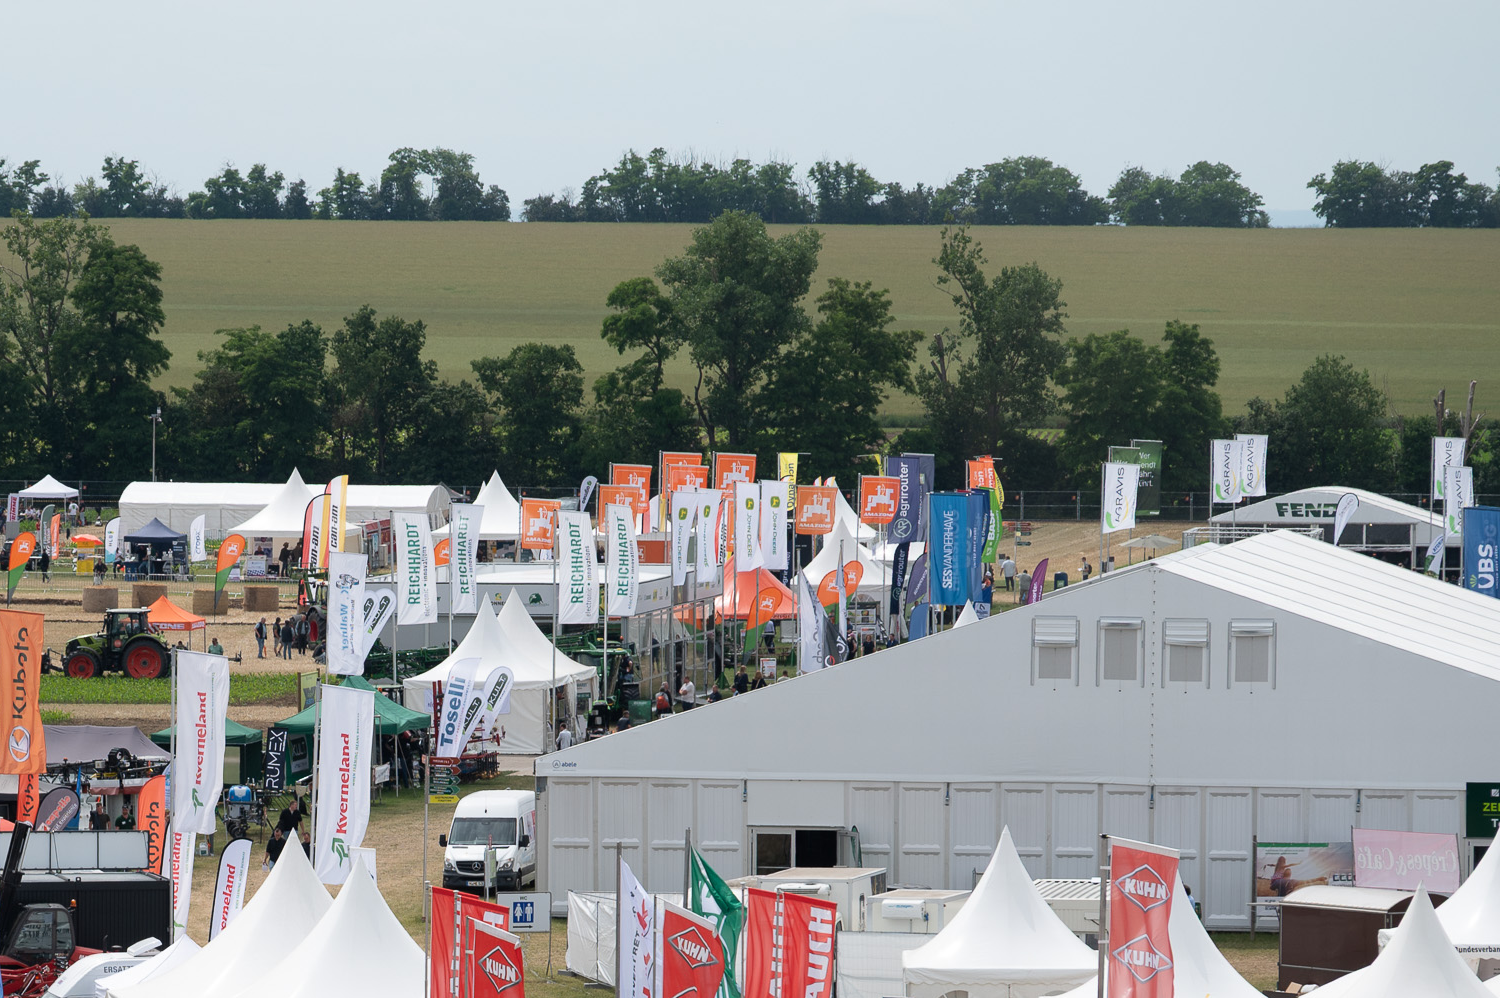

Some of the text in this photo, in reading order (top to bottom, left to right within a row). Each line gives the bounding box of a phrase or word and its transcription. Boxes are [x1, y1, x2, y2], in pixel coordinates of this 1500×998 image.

[900, 462, 910, 517] agrirouter
[1115, 467, 1125, 522] AGRAVIS
[1275, 502, 1338, 518] FEND
[331, 505, 339, 548] can-am
[942, 510, 954, 589] SESVANDERHAVE
[406, 523, 420, 604] REICHHARDT
[458, 516, 470, 594] REICHHARDT
[569, 522, 584, 604] REICHHARDT
[617, 516, 629, 596] REICHHARDT
[1478, 544, 1495, 589] UBS
[12, 627, 29, 719] Kubota
[488, 674, 507, 706] KULT
[195, 691, 206, 785] Kverneland
[440, 677, 466, 746] Toselli
[463, 699, 481, 731] KULT
[22, 774, 35, 817] Kubo
[45, 795, 71, 826] capello
[335, 733, 350, 834] Kverneland
[146, 801, 159, 869] Kubota
[221, 863, 236, 931] erneland
[1124, 877, 1166, 899] KUHN
[103, 965, 134, 974] ERSAT
[486, 957, 516, 982] KUHN
[677, 937, 709, 963] KUHN
[1124, 948, 1159, 969] KUHN
